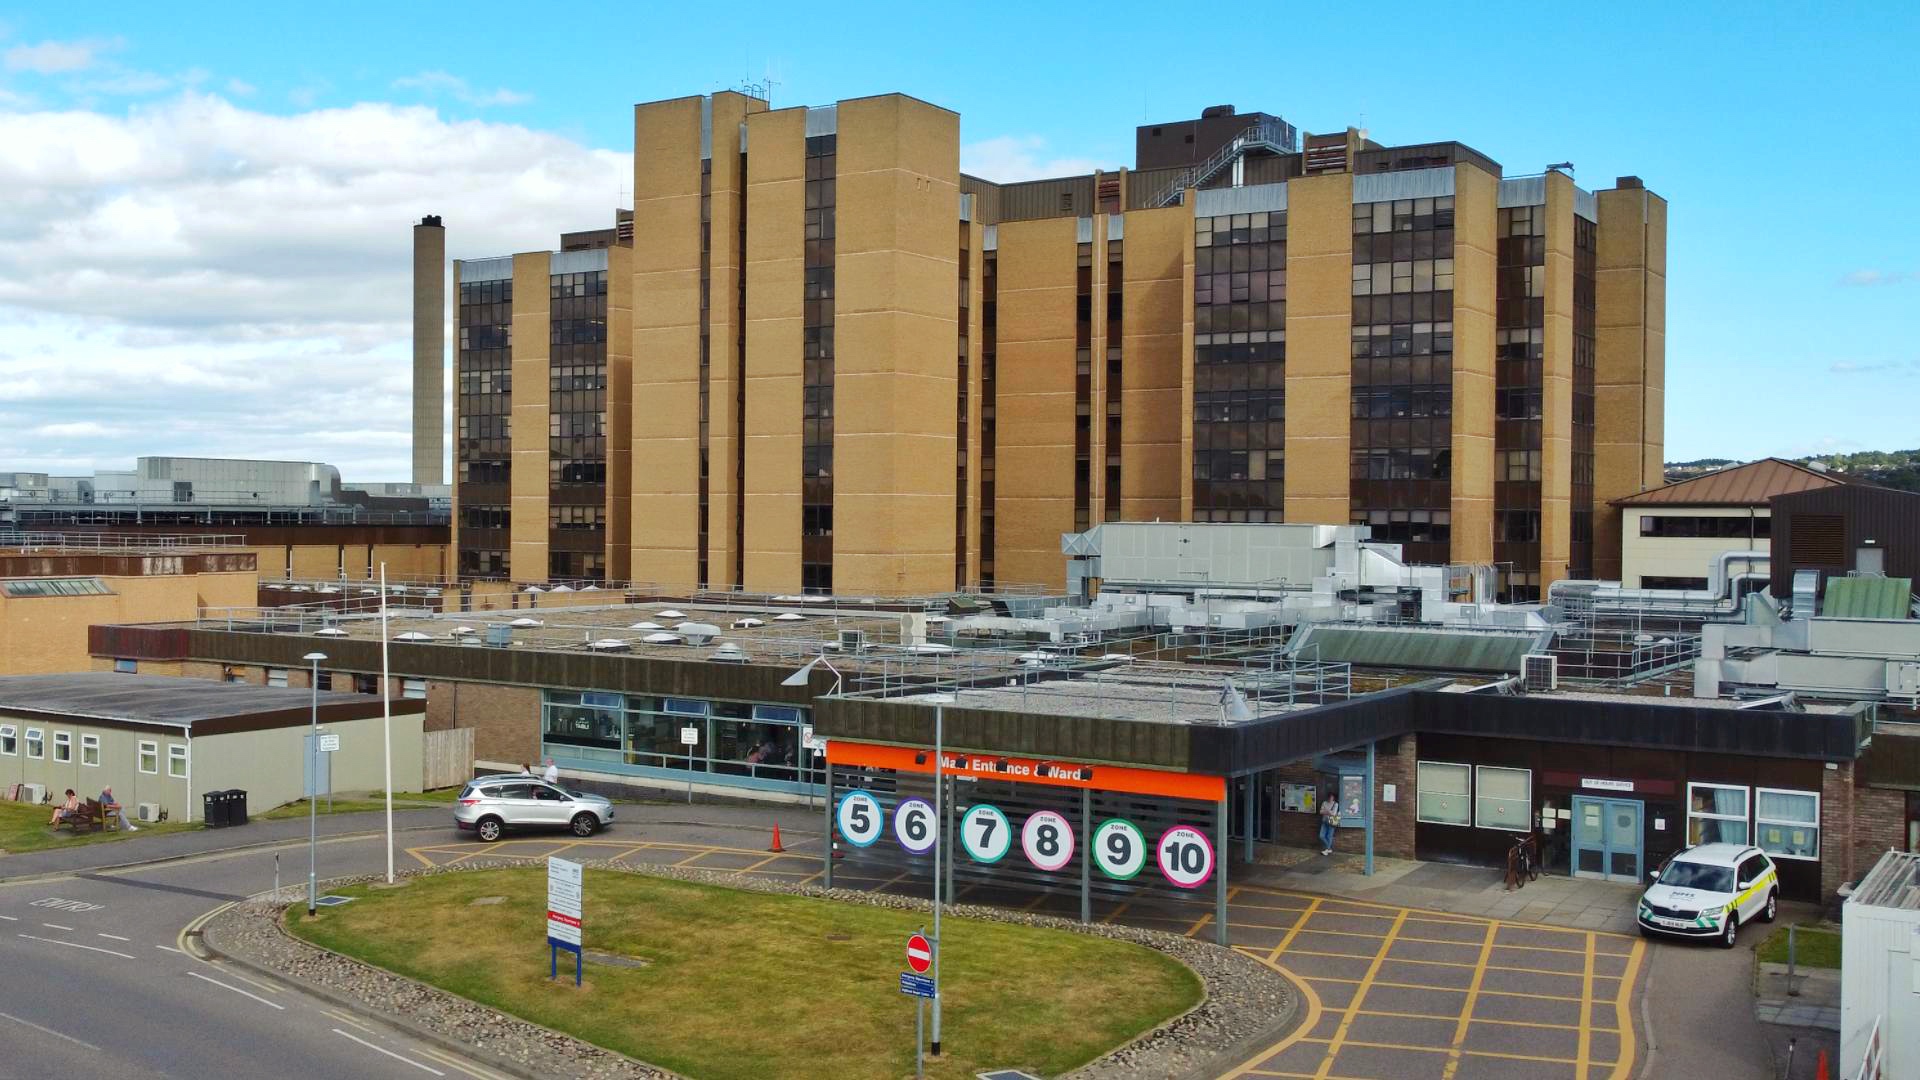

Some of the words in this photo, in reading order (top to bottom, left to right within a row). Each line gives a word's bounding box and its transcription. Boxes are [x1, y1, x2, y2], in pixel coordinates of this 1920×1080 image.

[1048, 766, 1088, 782] Ward
[850, 804, 870, 834] 5
[905, 810, 927, 841] 6
[975, 817, 997, 848] 7
[1036, 824, 1060, 857] 8
[1107, 832, 1131, 865] 9
[1176, 831, 1194, 839] ZONE
[1165, 841, 1205, 875] 10
[29, 897, 105, 913] ENTRY
